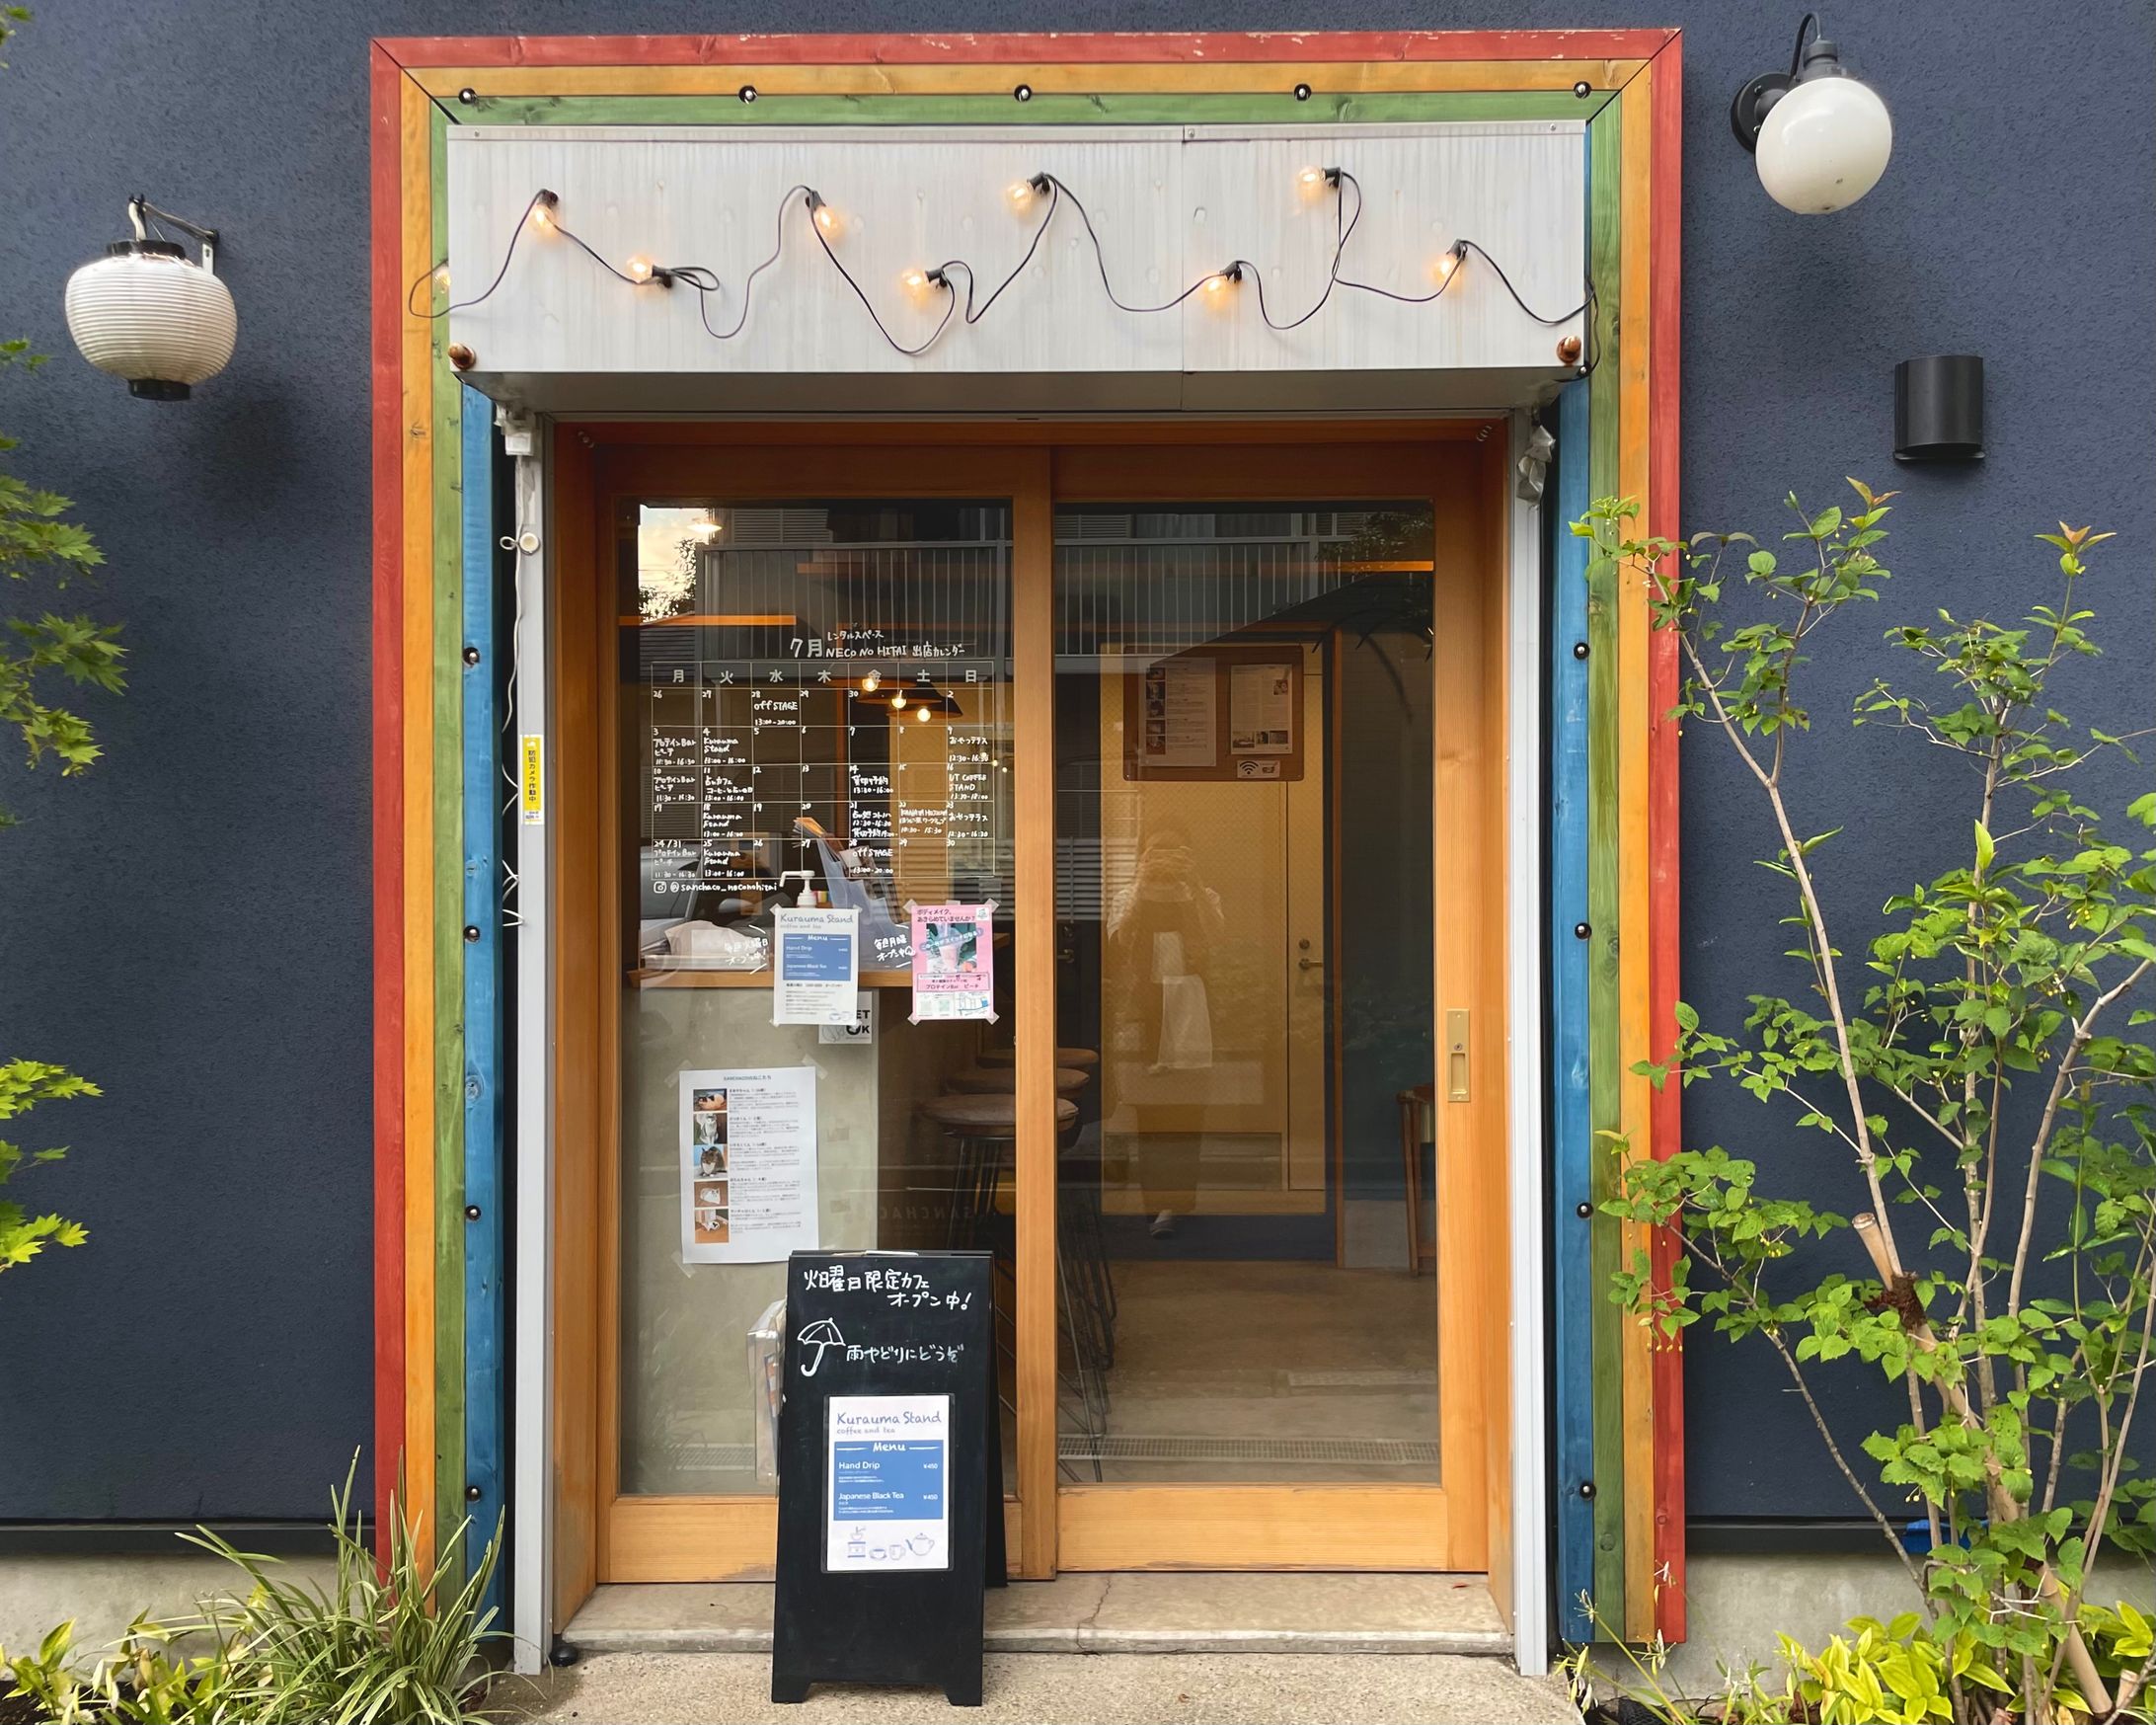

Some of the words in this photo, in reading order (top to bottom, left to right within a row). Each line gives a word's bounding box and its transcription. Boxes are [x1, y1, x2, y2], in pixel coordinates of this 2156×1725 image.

[827, 630, 885, 641] レンタルスペース
[878, 645, 907, 656] HITAI
[912, 641, 965, 658] 出店カレンダー
[673, 669, 684, 682] 月
[720, 670, 733, 684] 火
[769, 669, 783, 682] 水
[818, 670, 831, 683] 木
[868, 668, 882, 683] 金
[917, 669, 930, 682] 土
[965, 669, 977, 683] 日
[773, 702, 798, 711] STAGE
[868, 848, 893, 857] STAGE
[780, 913, 824, 923] Kurauma
[826, 914, 853, 923] Stand
[856, 1010, 871, 1019] ET
[804, 1265, 930, 1293] 火曜日限定カフェ
[846, 1343, 964, 1364] 雨やどりにどうぞ
[837, 1412, 899, 1425] Kurauma
[903, 1411, 942, 1424] Stand
[873, 1443, 906, 1452] Menu
[862, 1461, 881, 1471] Drip
[838, 1492, 871, 1501] Japanese
